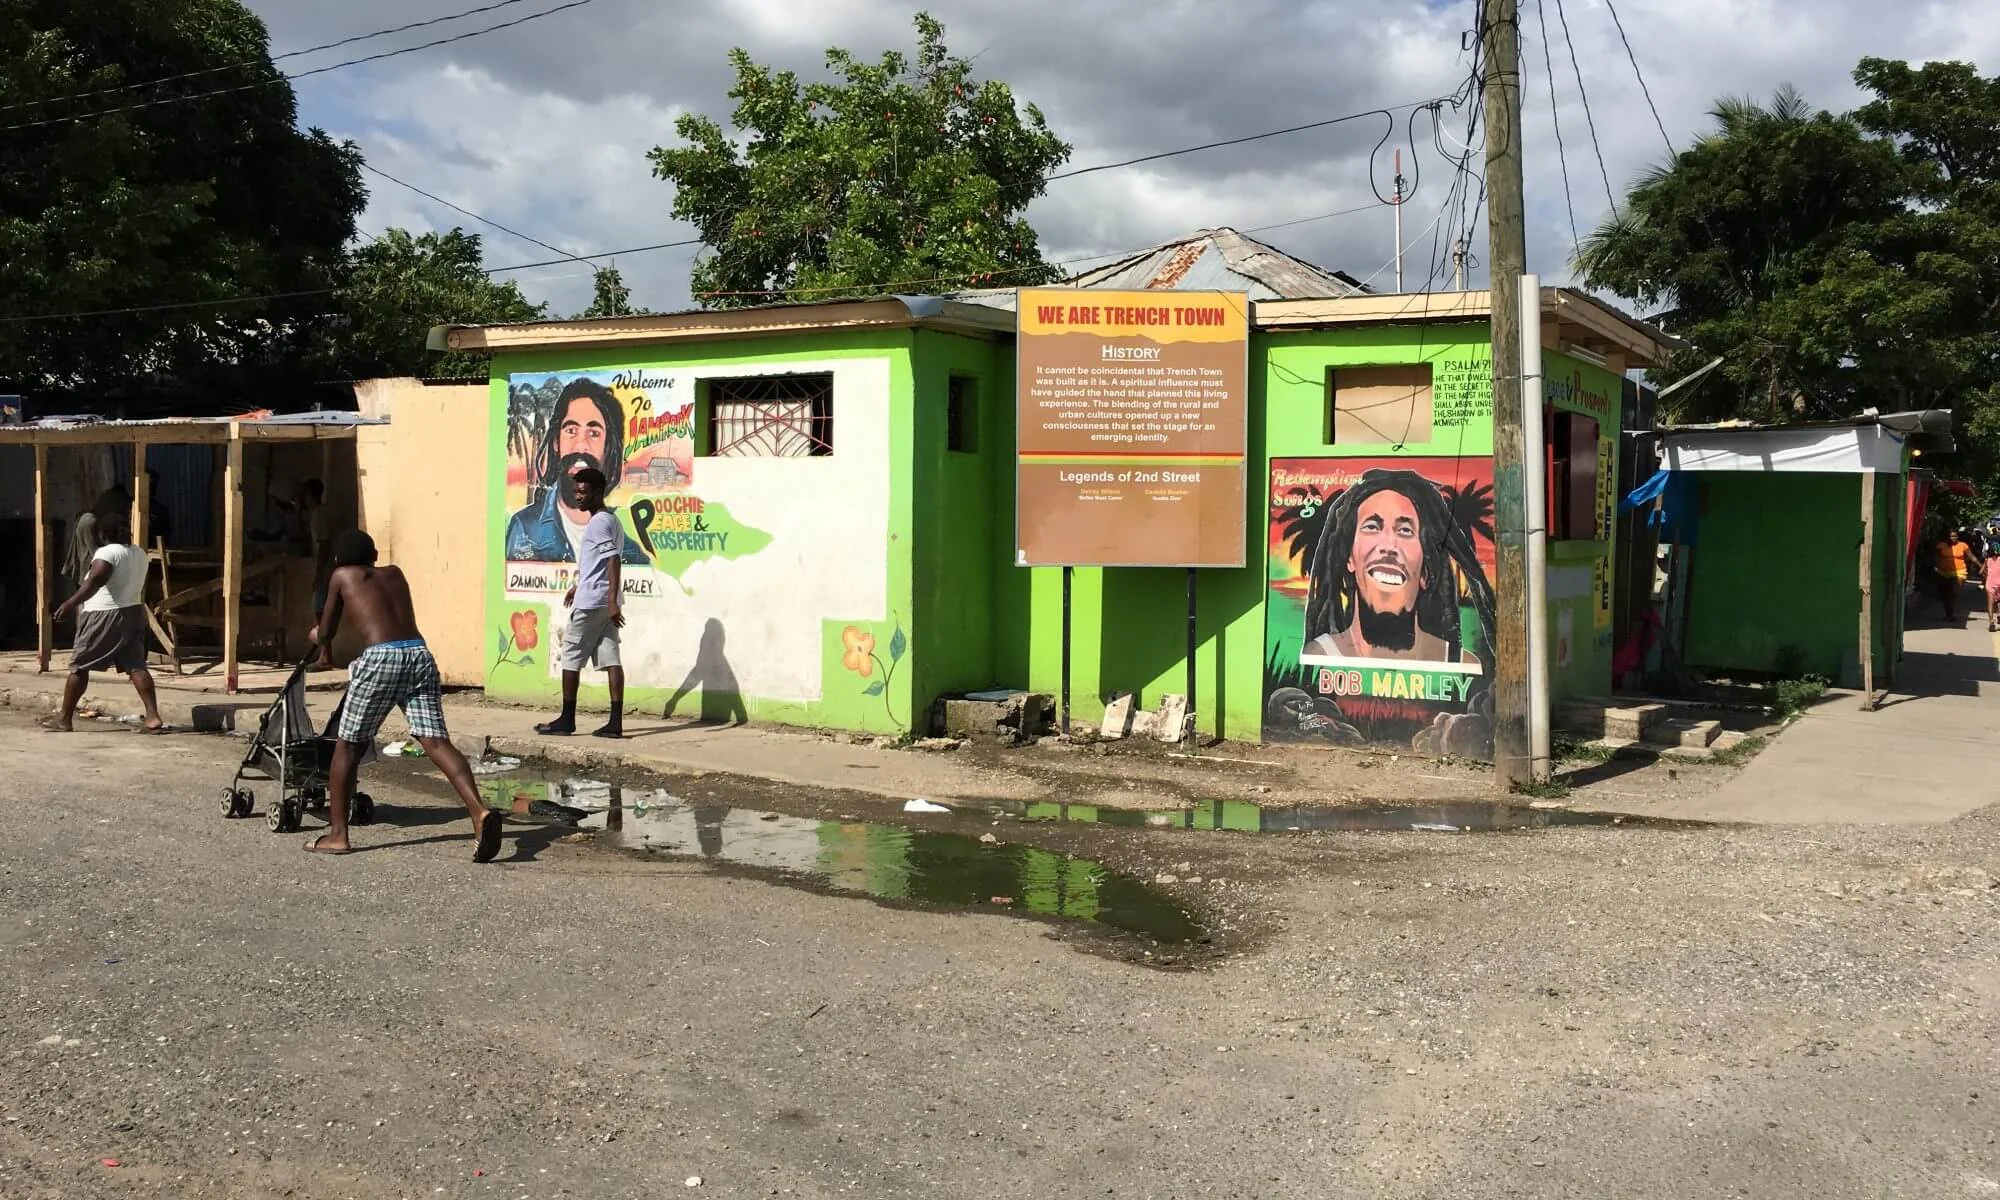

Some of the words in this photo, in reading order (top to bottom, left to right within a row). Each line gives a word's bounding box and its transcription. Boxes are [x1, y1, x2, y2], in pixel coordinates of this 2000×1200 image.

[1038, 306, 1064, 324] WE
[1069, 307, 1100, 324] ARE
[1104, 307, 1169, 325] TRENCH
[1175, 308, 1224, 326] TOWN
[1444, 360, 1480, 370] PSALM
[1482, 360, 1491, 369] 91
[1037, 366, 1045, 374] It
[1046, 366, 1075, 374] cannot
[1091, 367, 1144, 375] coincidental
[611, 369, 676, 390] Welcome
[1091, 378, 1096, 386] it
[1099, 378, 1109, 386] is.
[1111, 378, 1118, 386] A
[1120, 378, 1155, 387] spiritual
[1158, 379, 1198, 387] influence
[1447, 374, 1464, 382] THAT
[1467, 373, 1492, 382] DWELL
[1434, 383, 1442, 391] IN
[1443, 383, 1457, 391] THE
[1055, 389, 1085, 398] guided
[1103, 389, 1126, 397] hand
[1147, 390, 1182, 398] planned
[1185, 390, 1201, 398] this
[1203, 390, 1228, 399] living
[1434, 392, 1443, 400] OF
[631, 396, 652, 416] To
[1040, 400, 1090, 408] experience.
[1112, 400, 1150, 409] blending
[1434, 401, 1452, 409] SHALL
[1474, 399, 1493, 408] UNDE
[1125, 412, 1158, 421] opened
[624, 402, 695, 460] JAMROCK
[1043, 422, 1109, 430] consciousness
[1163, 423, 1188, 432] stage
[1091, 434, 1133, 442] emerging
[1135, 434, 1169, 442] identity.
[1060, 471, 1114, 484] Legends
[1118, 471, 1132, 482] of
[1135, 471, 1158, 482] 2nd
[1162, 471, 1200, 482] Street
[1271, 468, 1366, 490] Redemption
[1273, 489, 1323, 518] Songs
[694, 514, 709, 531] &
[510, 575, 547, 589] DAMION
[622, 579, 653, 594] ARLEY
[1319, 669, 1362, 696] BOB
[1372, 671, 1474, 702] MARLEY
